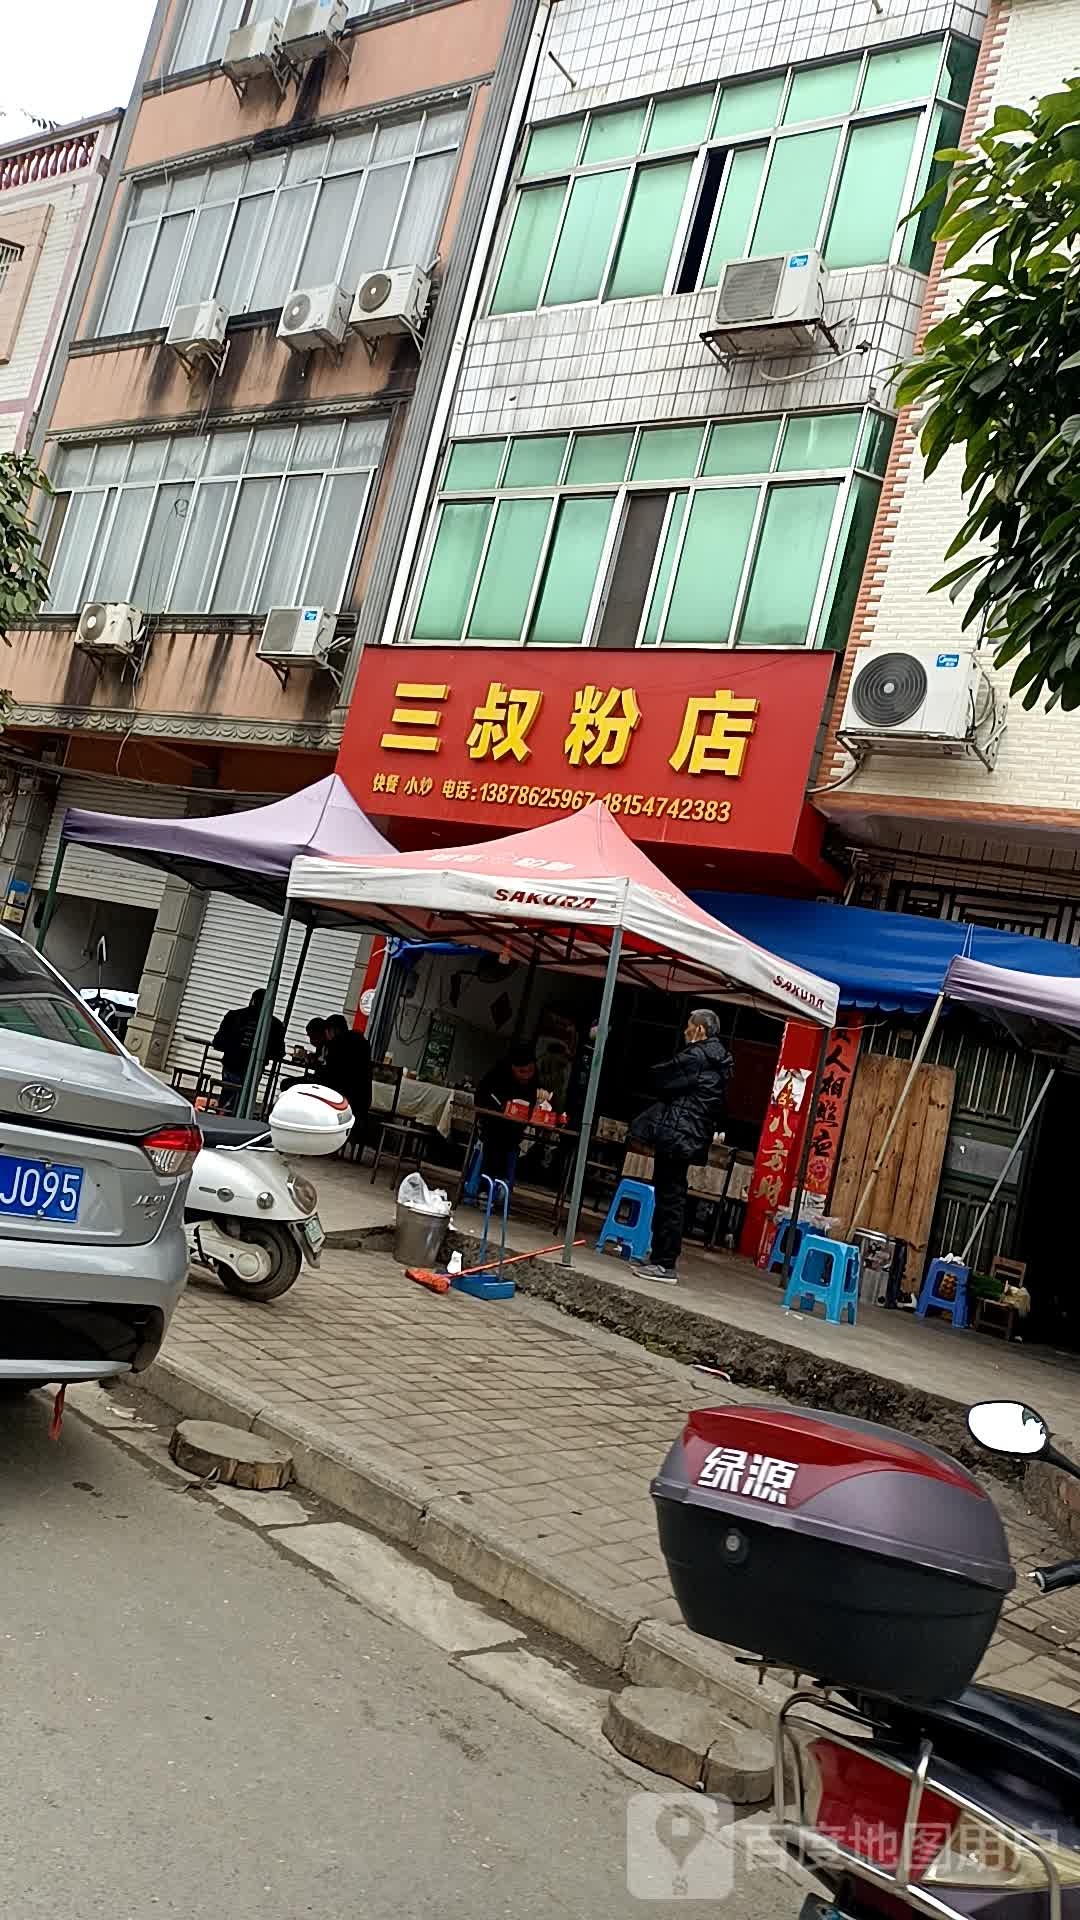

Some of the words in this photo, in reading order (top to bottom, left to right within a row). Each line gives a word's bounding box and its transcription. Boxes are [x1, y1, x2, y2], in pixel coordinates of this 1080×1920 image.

[380, 682, 760, 777] 三叔粉店
[404, 777, 433, 796] 小炒
[495, 888, 598, 909] SAKURA
[772, 975, 825, 1009] SAKURA
[698, 1446, 799, 1505] 绿源
